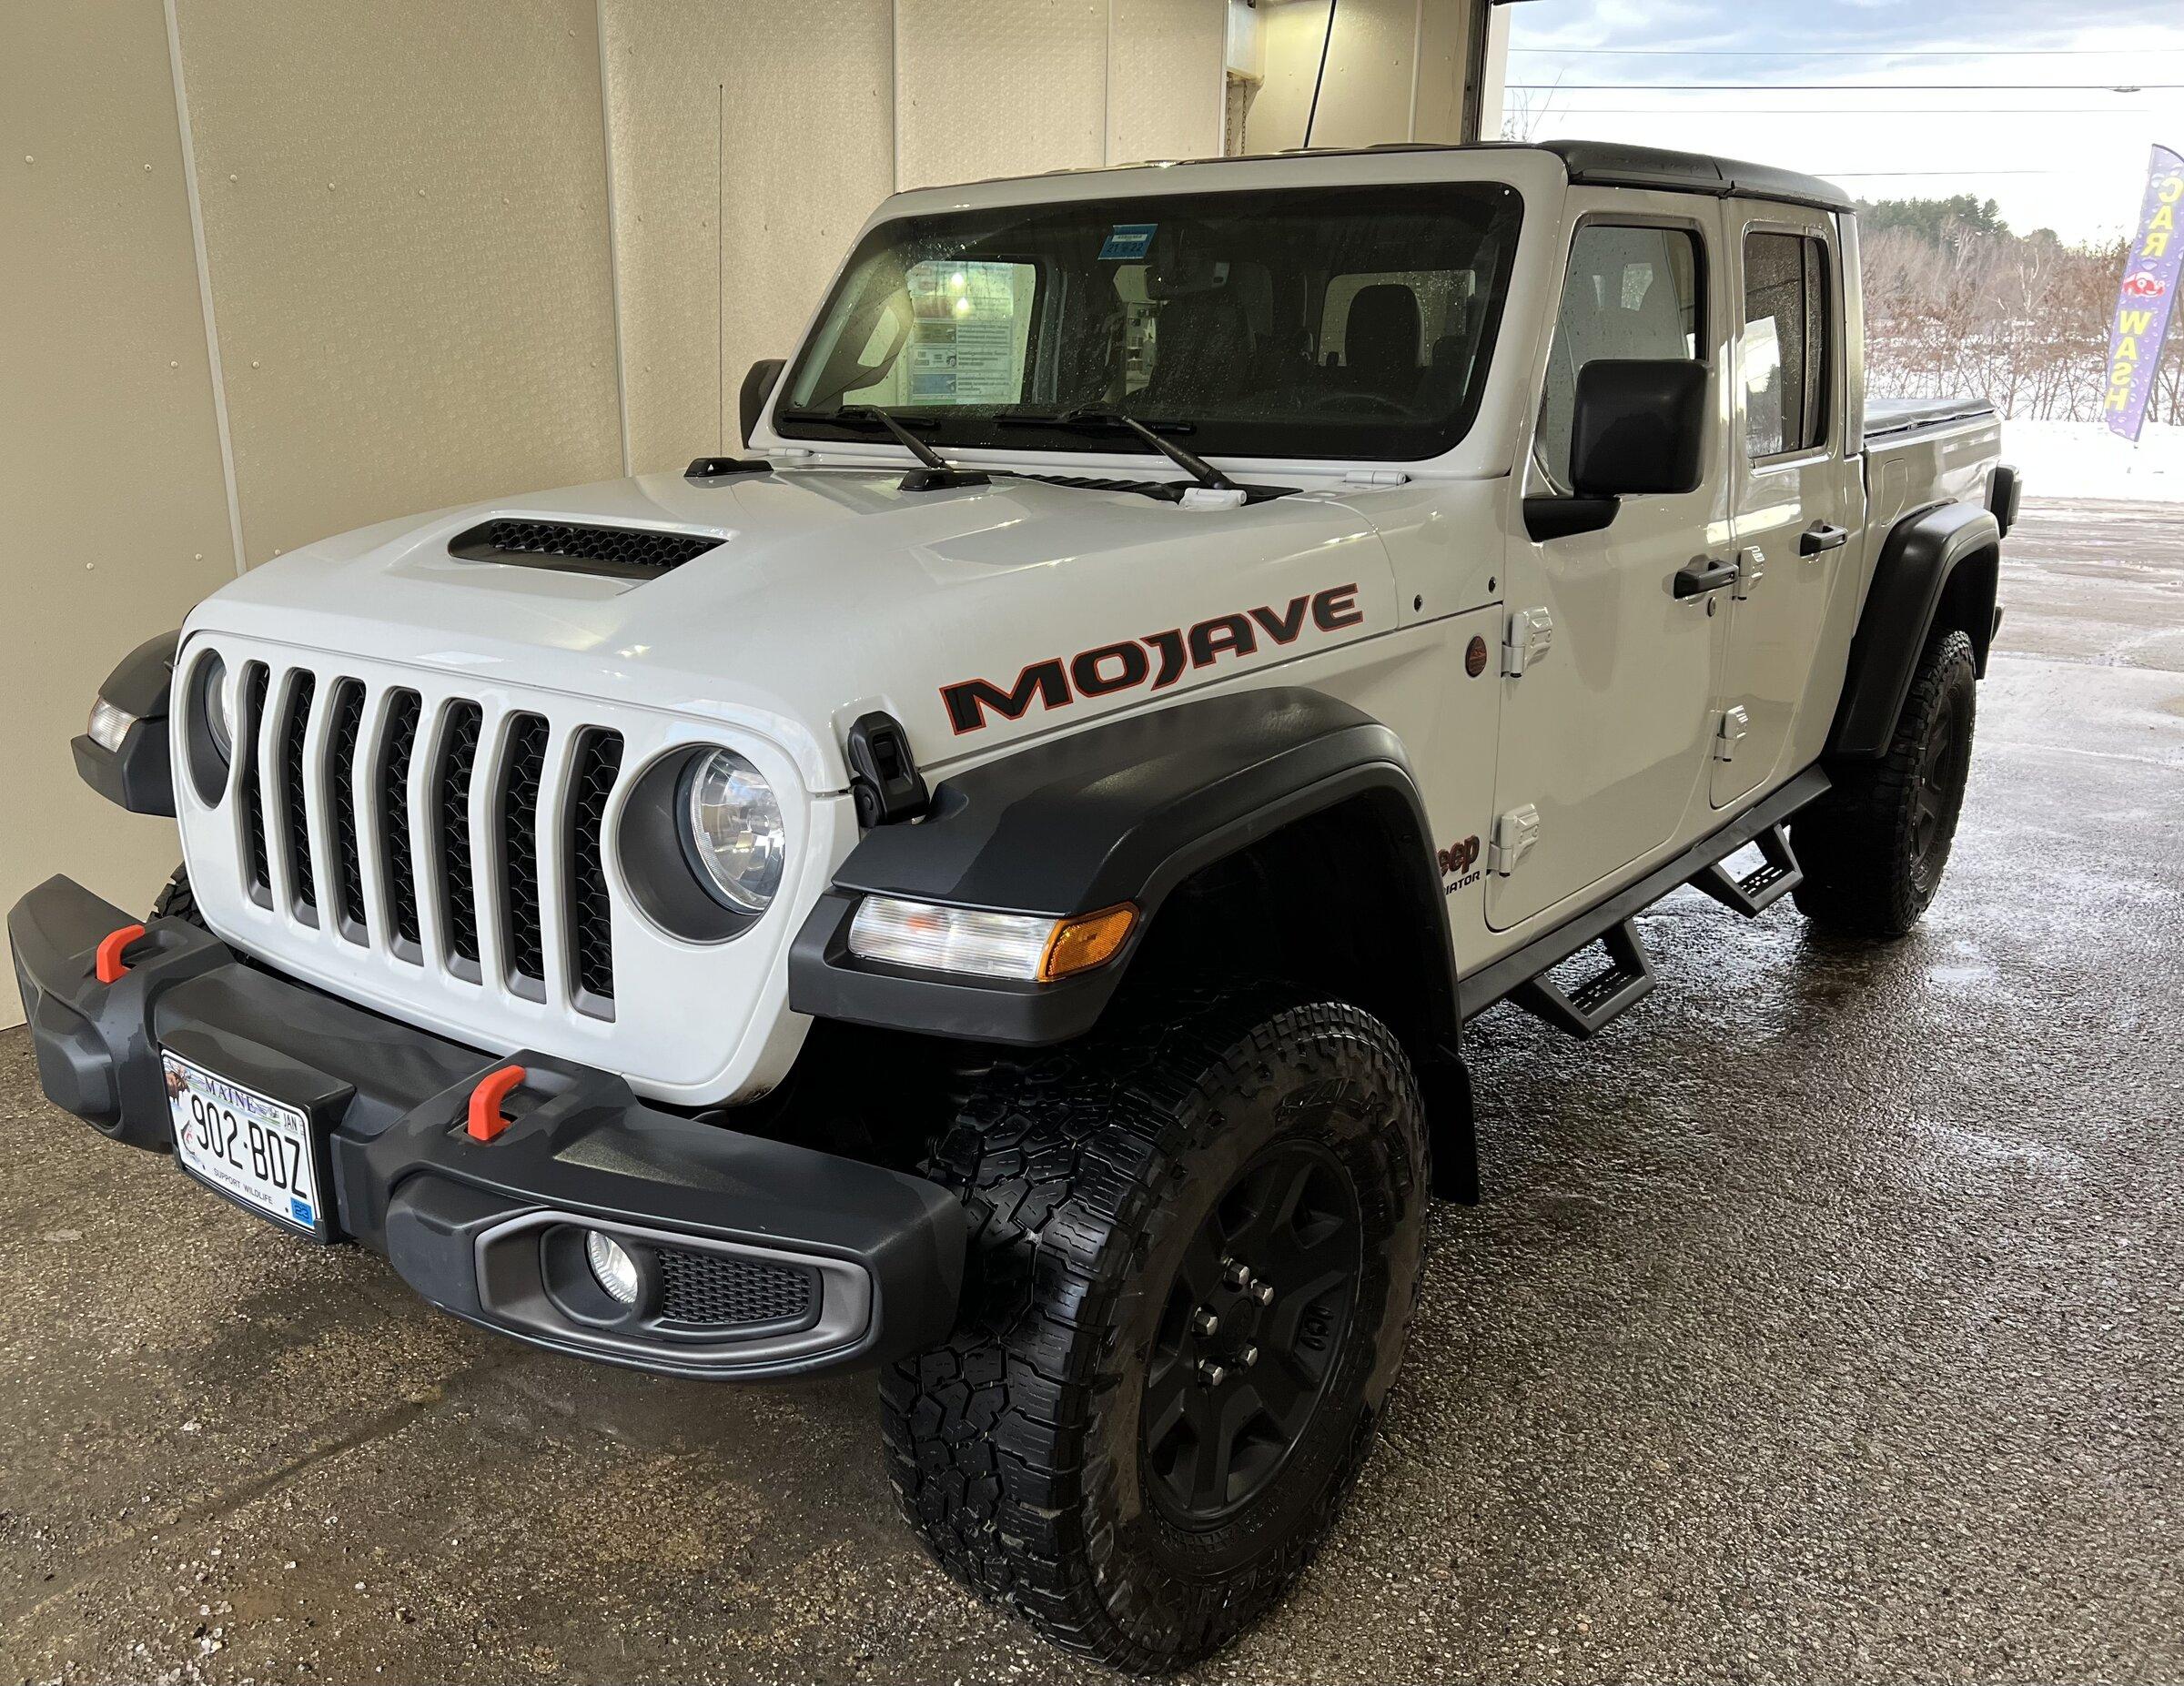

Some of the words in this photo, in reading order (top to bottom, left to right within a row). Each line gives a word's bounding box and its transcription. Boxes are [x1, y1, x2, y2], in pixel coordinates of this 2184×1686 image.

[938, 582, 1364, 735] MOJAVE
[1438, 834, 1481, 878] eep
[1445, 871, 1481, 895] IATOR
[204, 1076, 258, 1114] MAINE
[283, 1112, 298, 1131] JAN
[213, 1167, 241, 1189] SUPPORT
[243, 1182, 274, 1205] WILDLIFE
[294, 1205, 309, 1219] 23
